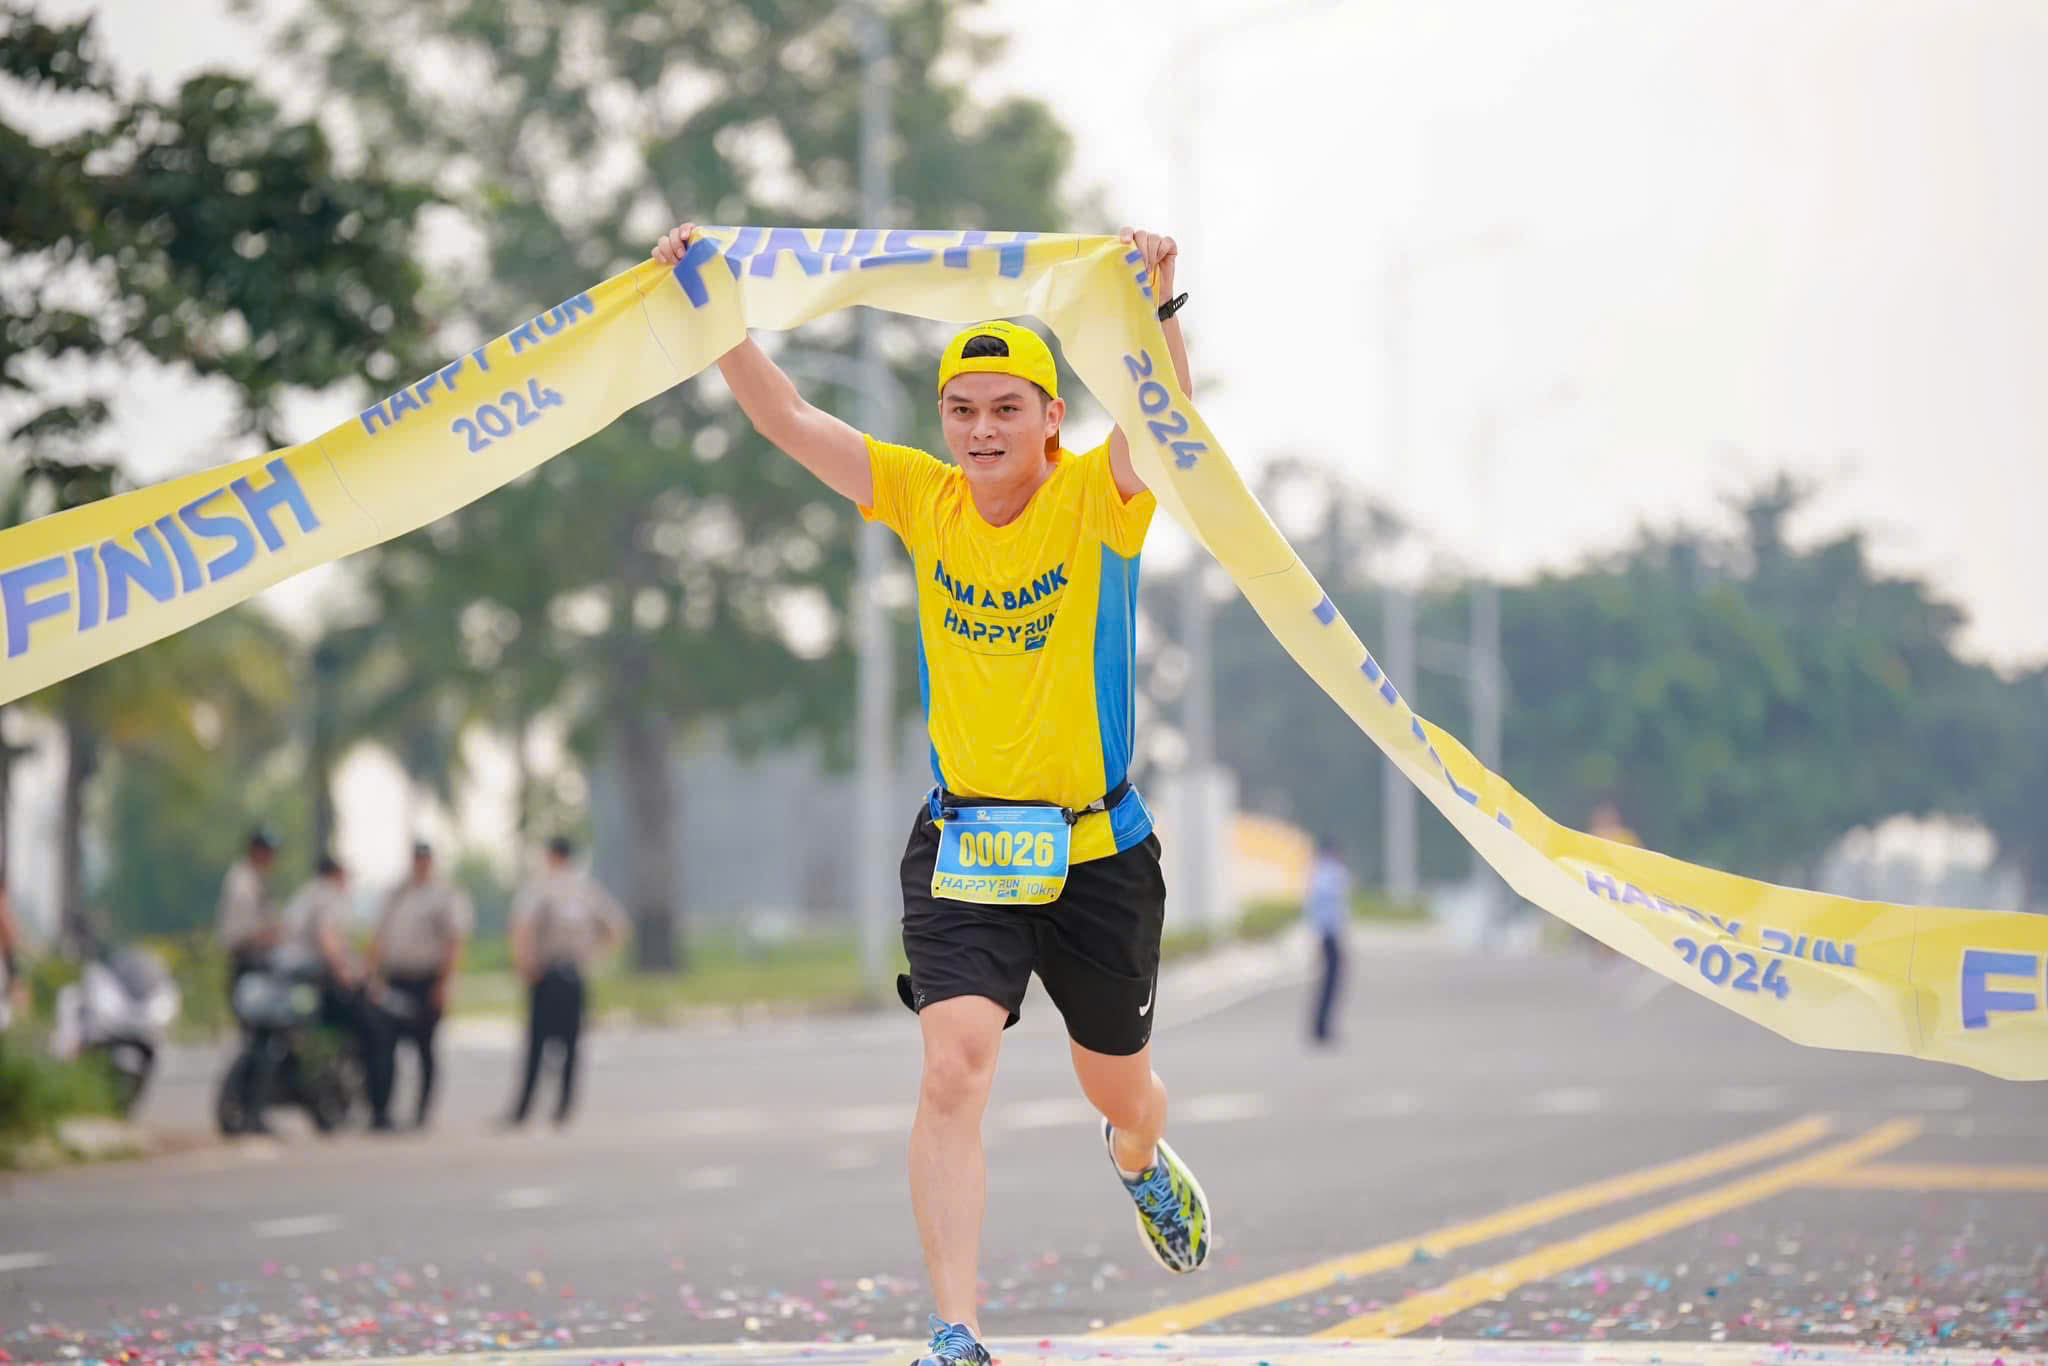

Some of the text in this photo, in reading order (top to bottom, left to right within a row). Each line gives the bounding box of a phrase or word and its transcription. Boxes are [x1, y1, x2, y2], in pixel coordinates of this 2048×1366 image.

[452, 378, 566, 453] 2024
[1123, 350, 1209, 469] 2024
[0, 457, 321, 659] FINISH
[1002, 562, 1068, 611] BANK
[944, 608, 1022, 643] HAPPY
[959, 831, 1055, 868] 00026
[941, 876, 997, 892] HAPPY
[1673, 938, 1790, 1000] 2024
